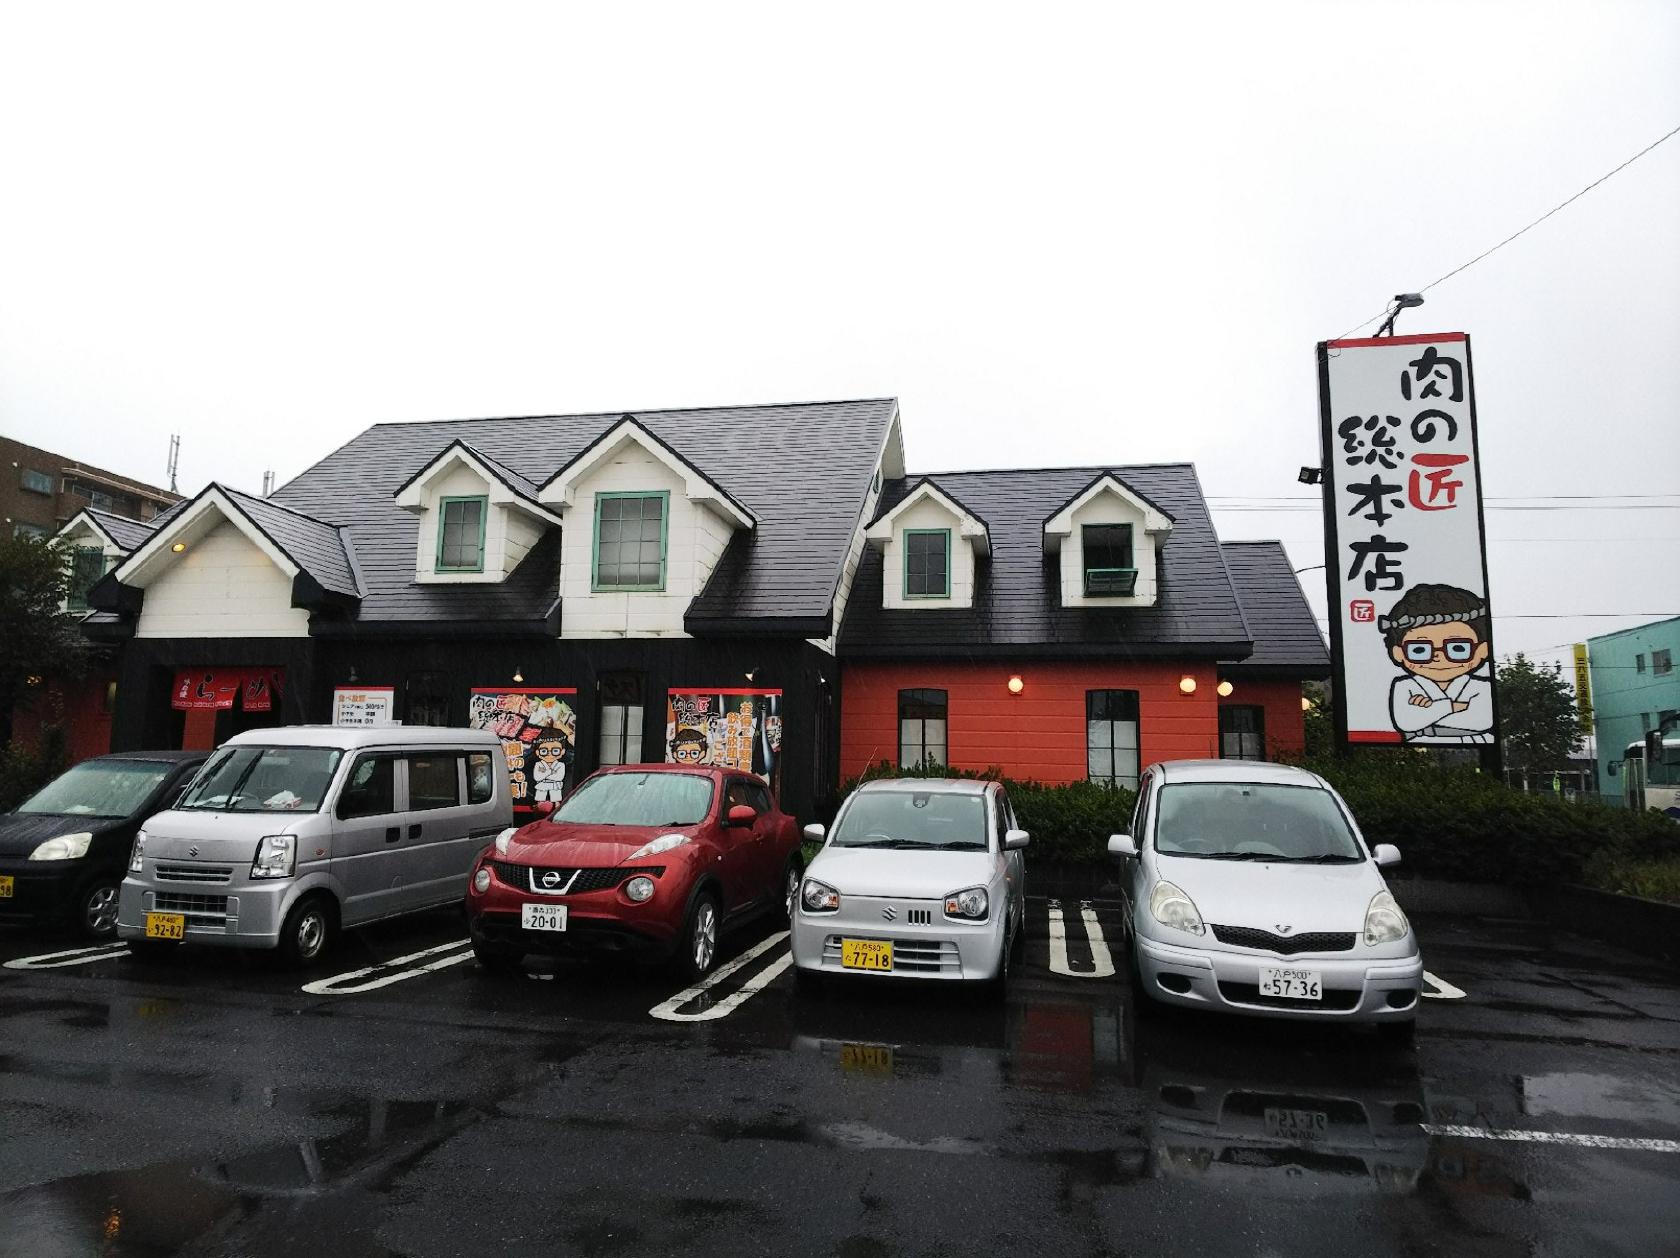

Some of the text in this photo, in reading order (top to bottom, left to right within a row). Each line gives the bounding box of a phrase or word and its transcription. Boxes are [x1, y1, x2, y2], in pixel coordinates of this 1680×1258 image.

[1401, 346, 1470, 511] 肉の匠
[1338, 414, 1409, 592] 総本店
[1352, 601, 1374, 621] 匠
[1273, 979, 1318, 996] 57-36
